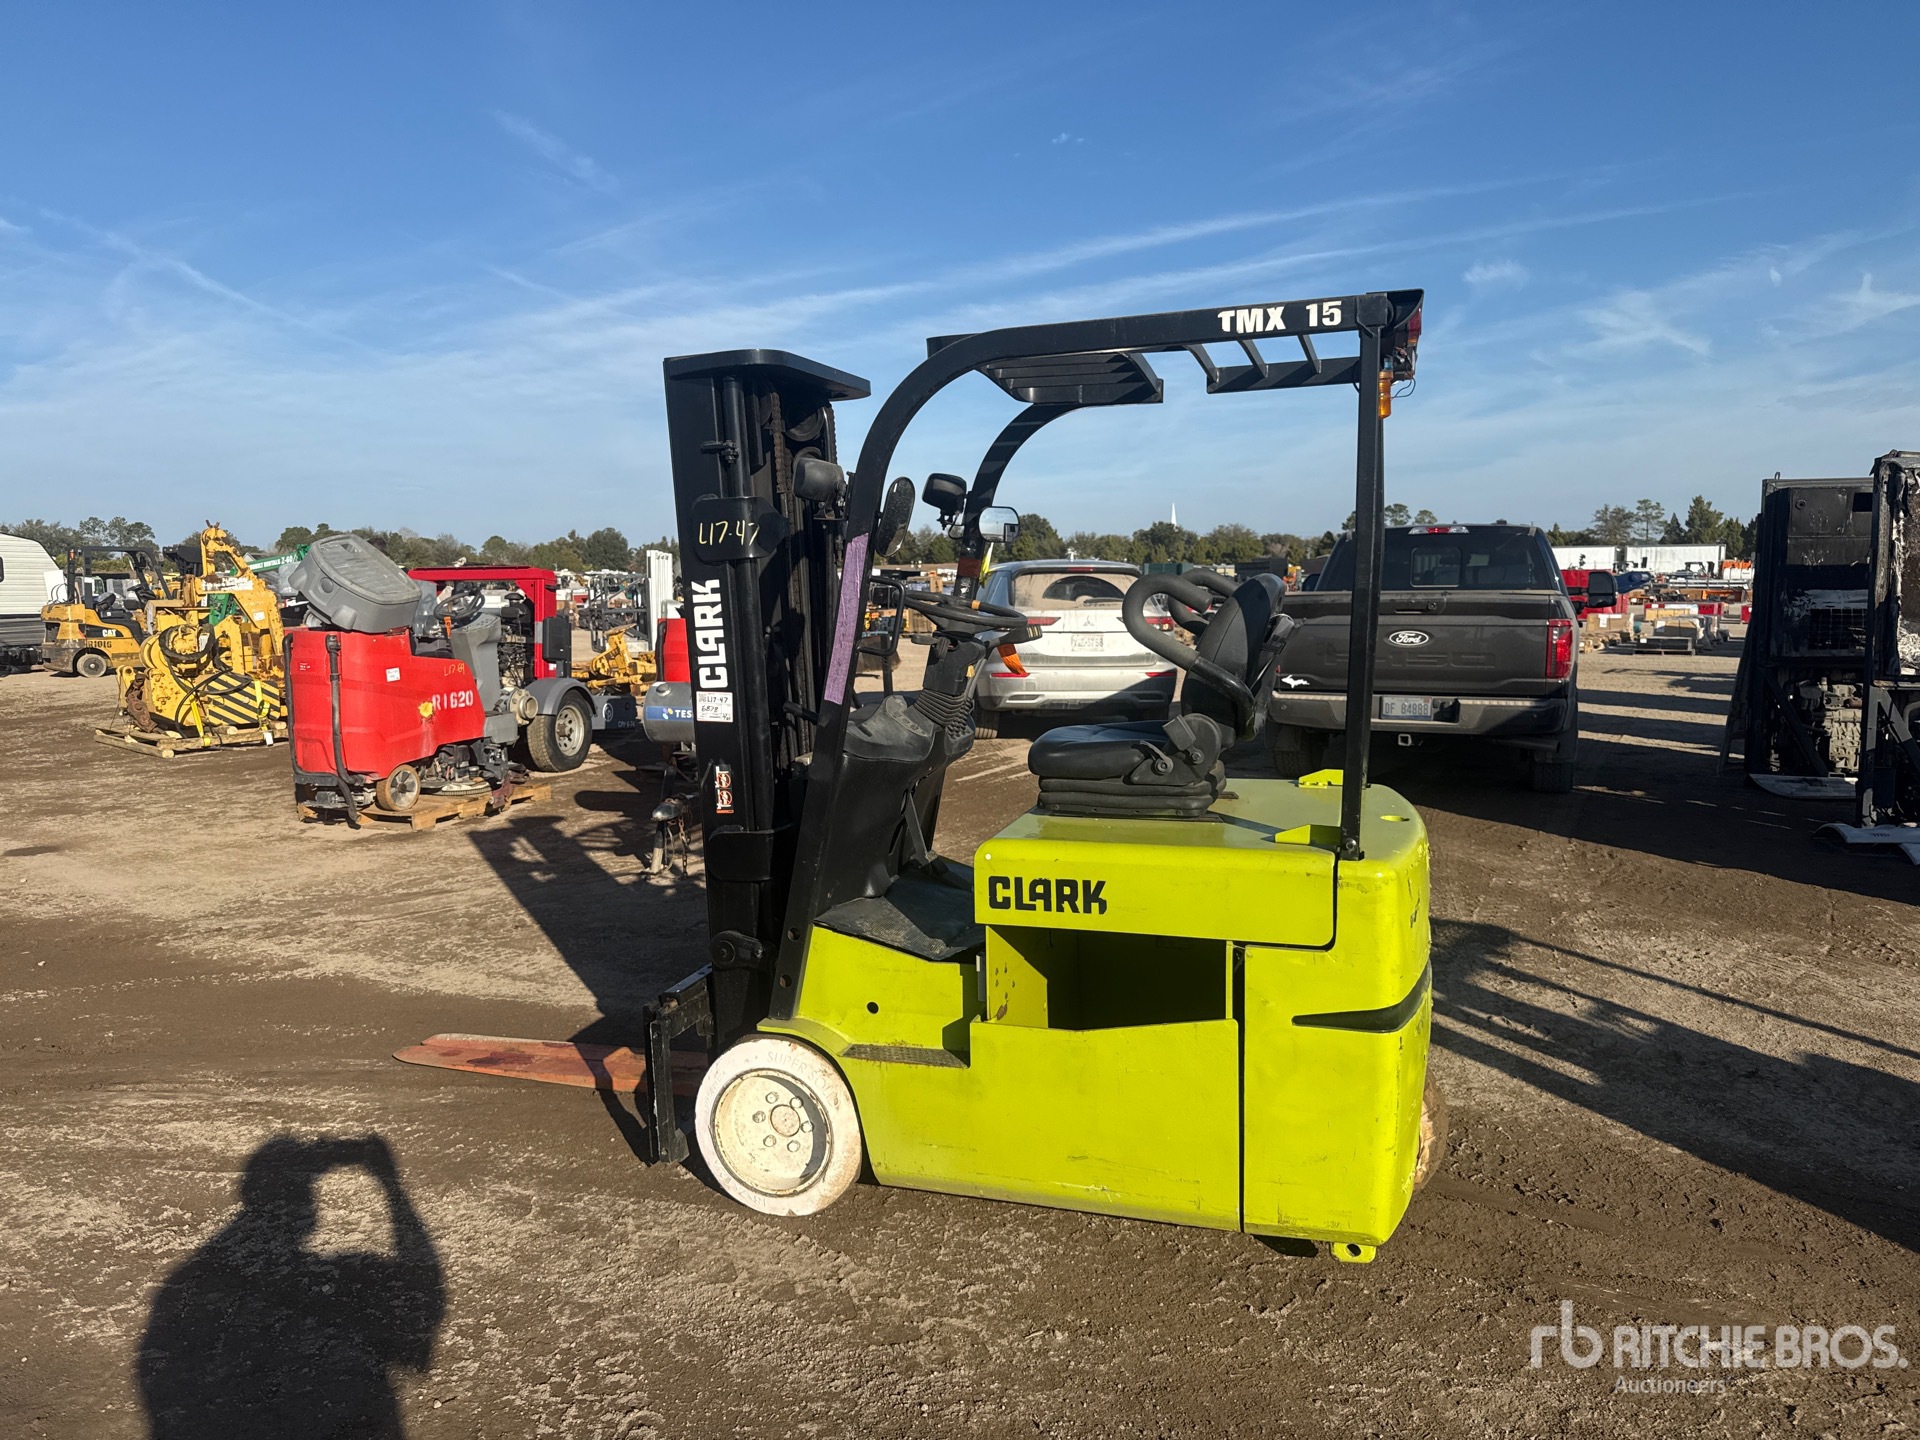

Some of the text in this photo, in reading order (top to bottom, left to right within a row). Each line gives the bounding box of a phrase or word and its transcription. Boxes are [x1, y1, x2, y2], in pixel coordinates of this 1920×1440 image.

[1217, 300, 1342, 334] TMX 15
[698, 519, 761, 547] L17-47
[102, 629, 117, 637] CAT
[691, 579, 728, 689] CLARK
[988, 875, 1108, 915] CLARK
